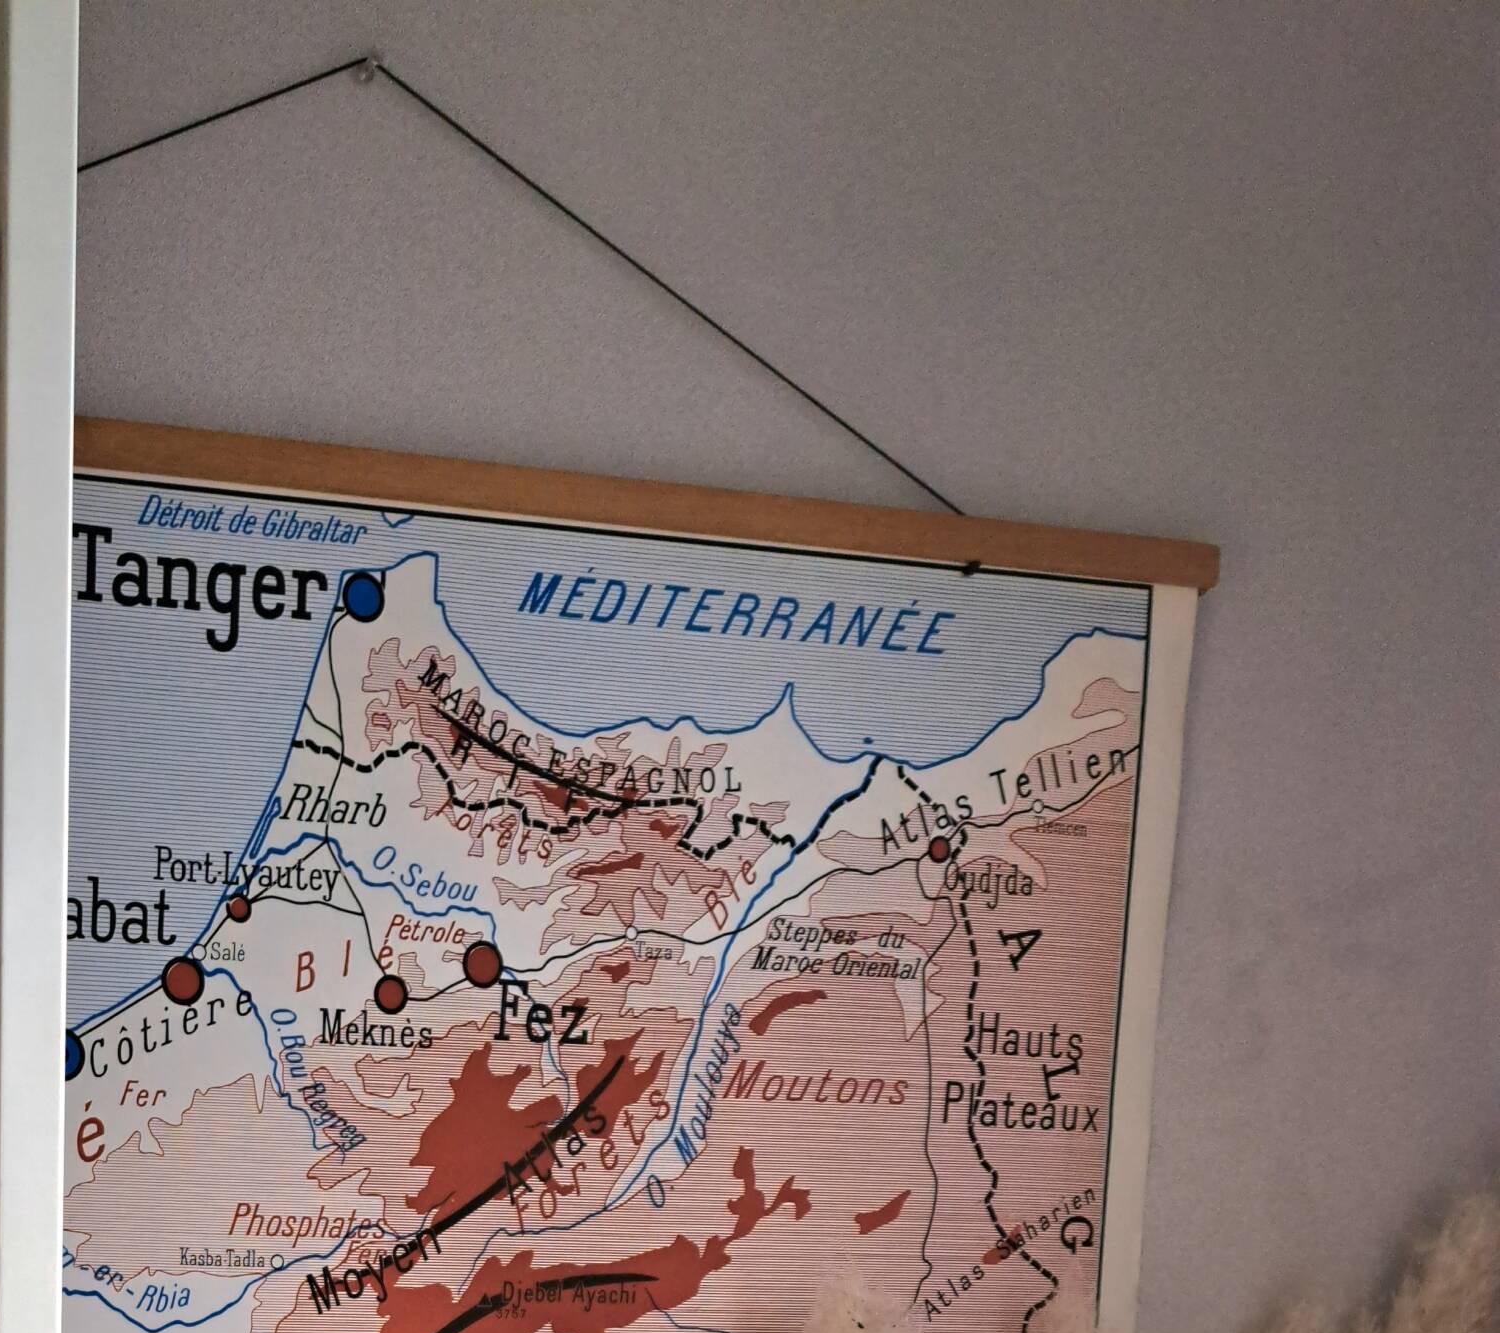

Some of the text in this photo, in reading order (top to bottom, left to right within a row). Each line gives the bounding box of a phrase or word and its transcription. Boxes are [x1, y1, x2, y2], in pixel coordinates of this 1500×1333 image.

[137, 494, 368, 545] Détroit de Gibraltar
[73, 523, 329, 652] Tanger
[517, 566, 956, 655] MÉDITERRANÉE
[418, 654, 742, 793] MAROC ESPAGNOL
[280, 783, 388, 828] Rharb
[881, 747, 1127, 855] Atlas Tellien
[401, 863, 479, 901] Sebou
[945, 861, 1033, 910] Oudjda
[67, 876, 178, 946] abat
[386, 913, 466, 945] Pétrole
[768, 918, 905, 952] Steppes du
[209, 942, 246, 962] Salé
[635, 940, 673, 961] Taza
[751, 946, 922, 980] Maroc Oriental
[90, 989, 254, 1079] Côtière
[318, 1007, 434, 1049] Meknès
[493, 978, 589, 1046] Fez
[976, 1011, 1084, 1062] Hauts
[280, 1034, 309, 1078] Bou
[118, 1079, 167, 1107] Fer
[674, 1002, 742, 1166] Moulouya
[722, 1059, 911, 1106] Moutons
[942, 1080, 1100, 1133] Plateaux
[227, 1202, 387, 1249] Phosphates
[305, 1226, 443, 1315] Moyen
[923, 1264, 986, 1323] Atlas
[501, 1279, 637, 1313] Djebel Ayachi
